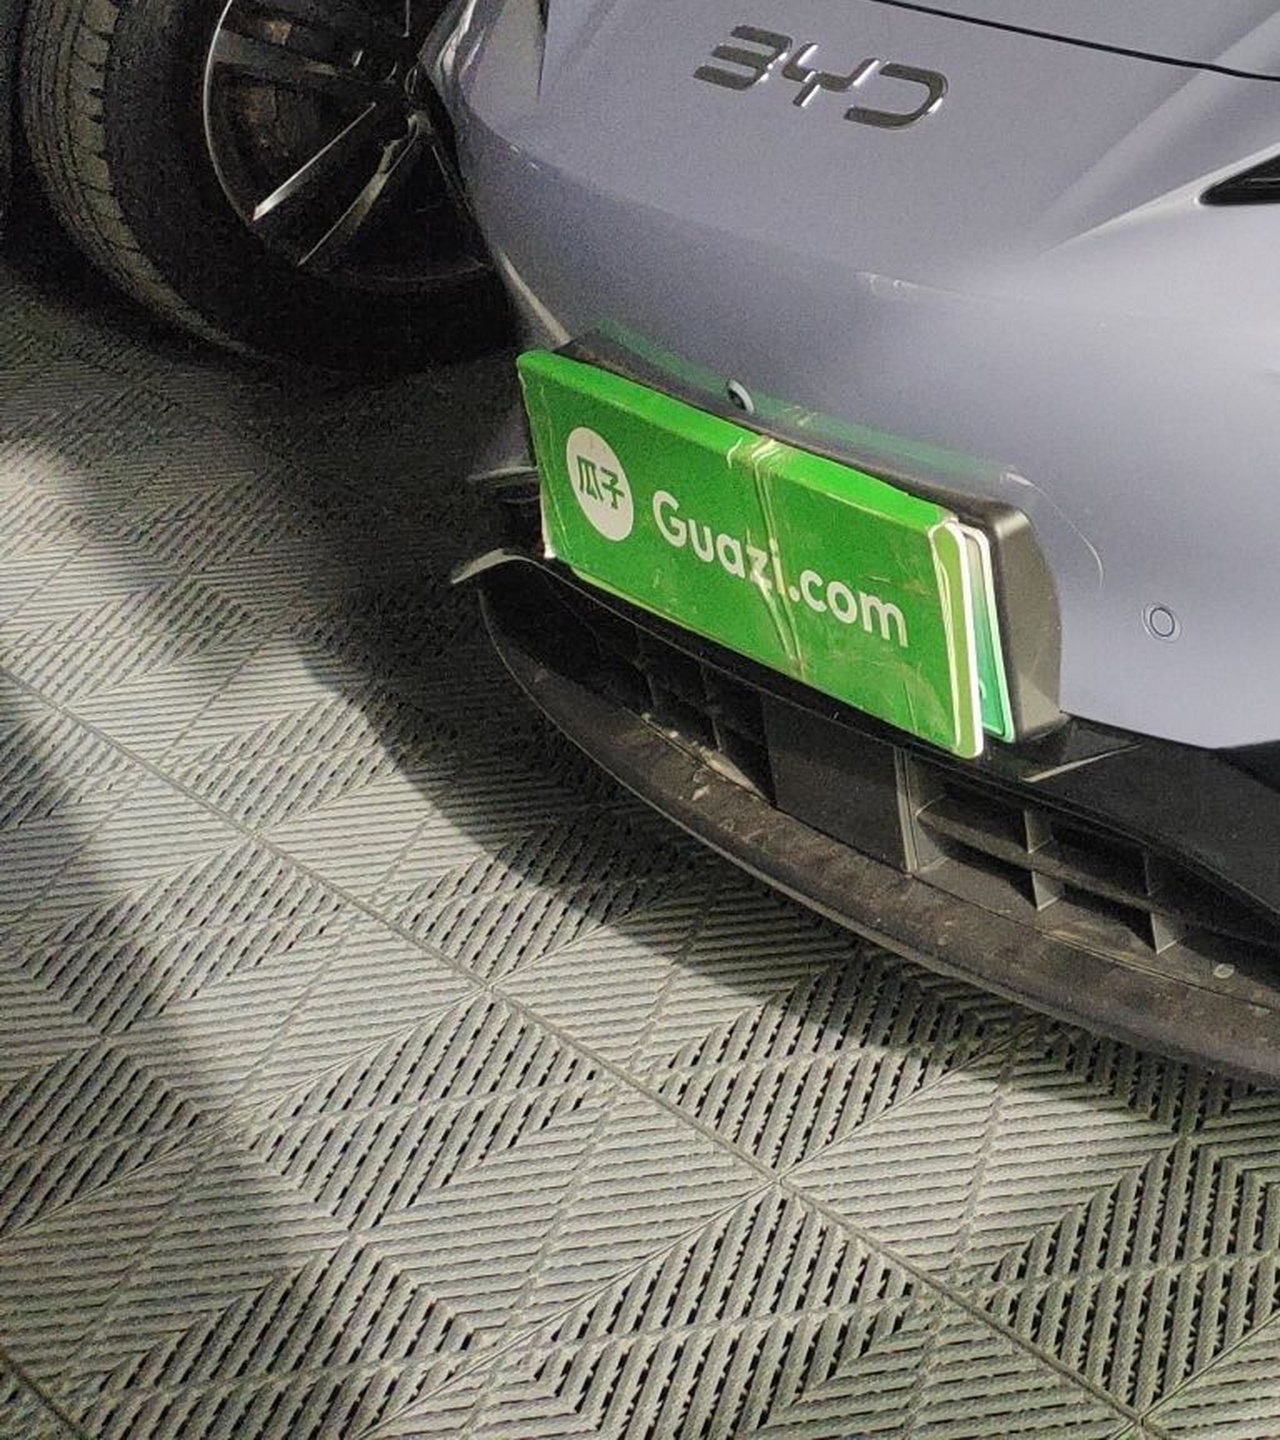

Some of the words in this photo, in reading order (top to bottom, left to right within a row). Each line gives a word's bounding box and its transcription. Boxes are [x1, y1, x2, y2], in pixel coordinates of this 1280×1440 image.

[692, 24, 950, 130] BYD
[576, 454, 626, 510] 瓜子
[652, 490, 909, 648] Guazi.com
